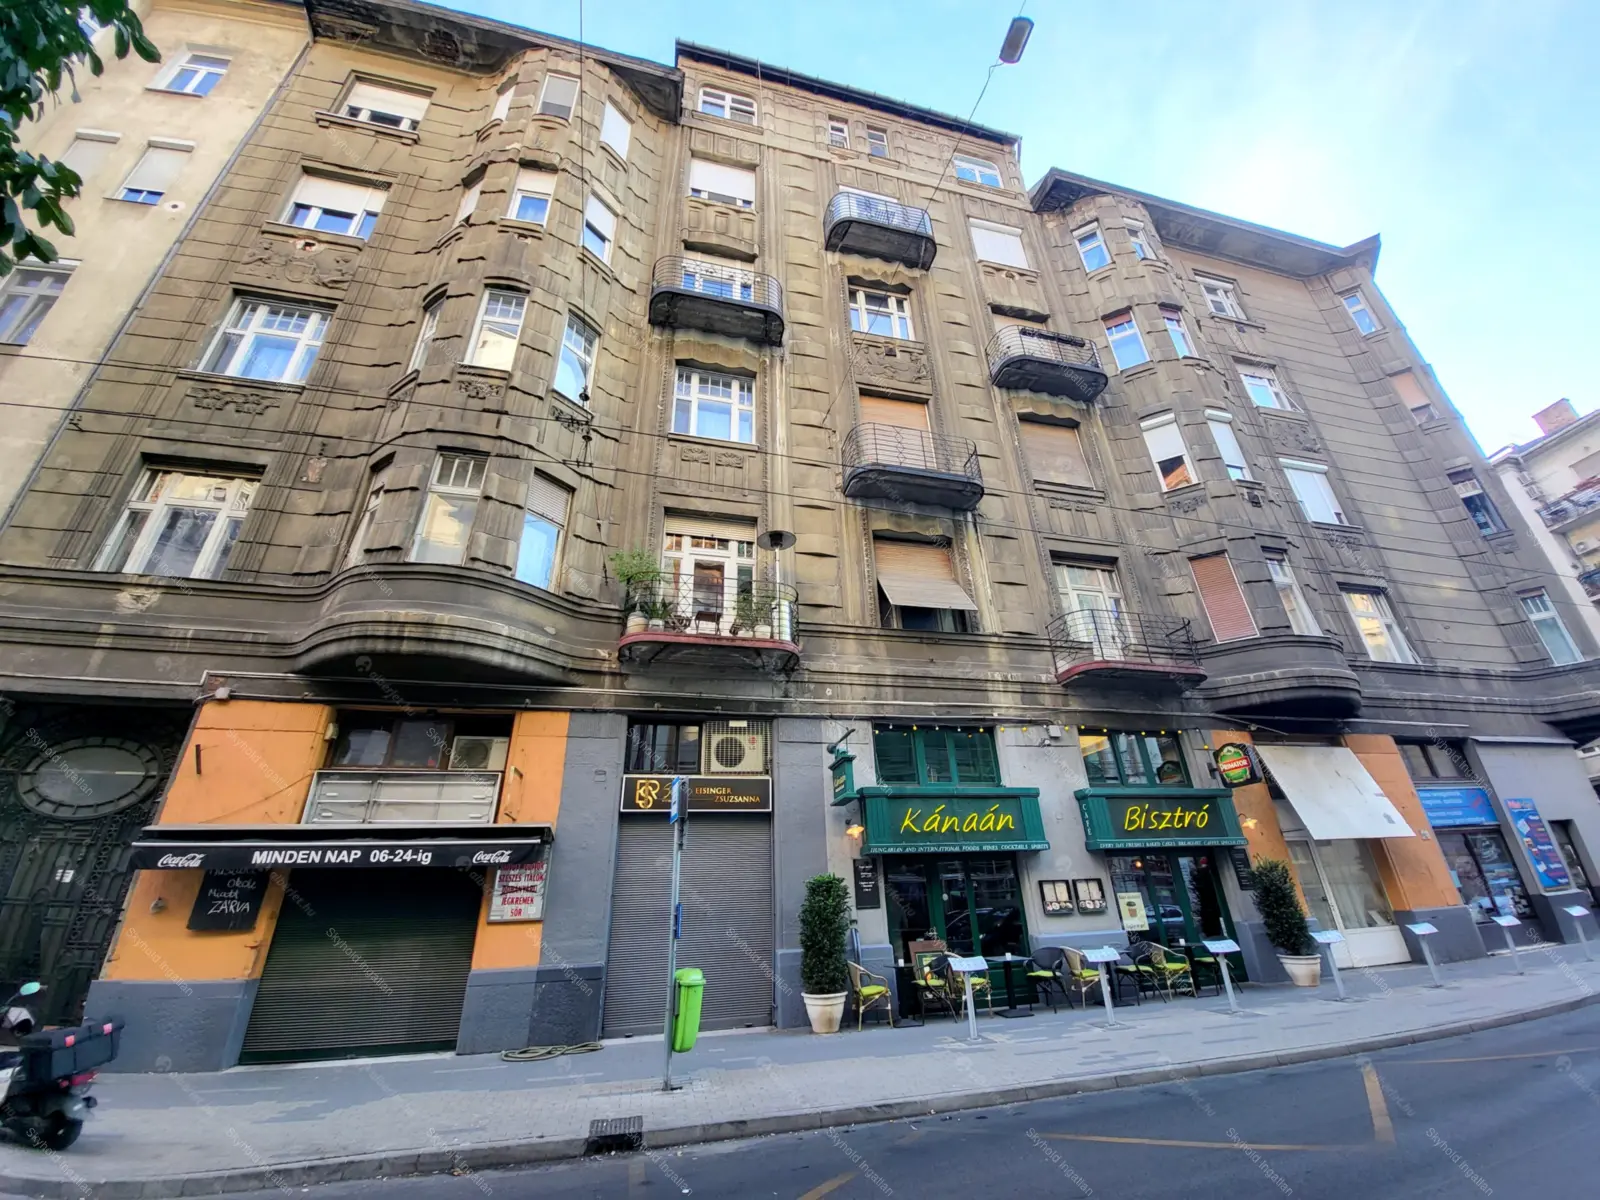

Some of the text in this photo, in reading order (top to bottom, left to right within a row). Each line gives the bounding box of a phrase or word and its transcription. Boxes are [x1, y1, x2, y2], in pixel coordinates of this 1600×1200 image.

[695, 786, 732, 794] EISINGER
[714, 795, 760, 803] ZSUZSANNA
[900, 804, 1014, 834] Kánaán
[1124, 804, 1210, 832] Bisztró
[252, 850, 432, 865] MINDEN NAP 06-24-ig
[498, 872, 544, 882] SZESZES ITALOK
